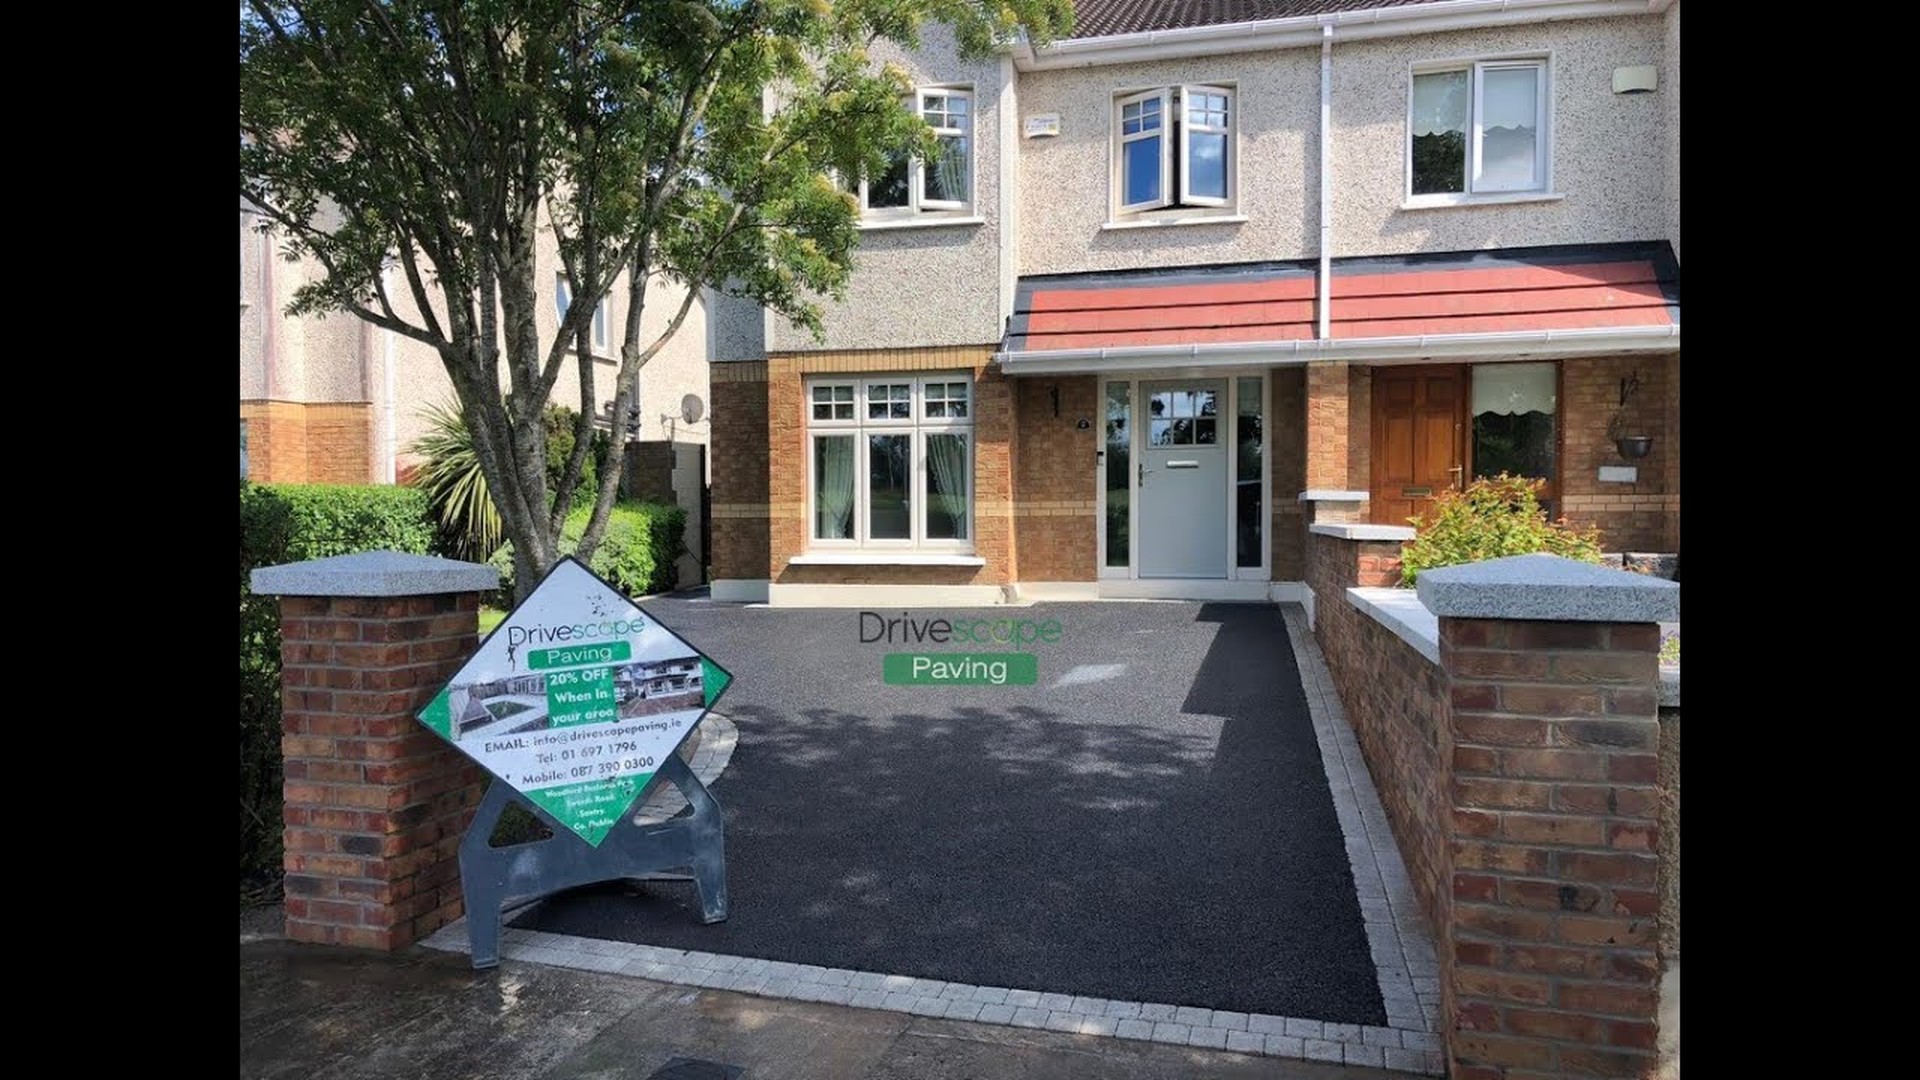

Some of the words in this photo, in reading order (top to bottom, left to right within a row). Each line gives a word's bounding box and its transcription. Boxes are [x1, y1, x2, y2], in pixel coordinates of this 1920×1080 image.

[508, 617, 645, 647] Drivescape
[547, 647, 612, 665] Paving
[549, 672, 578, 686] 20%
[581, 668, 609, 682] OFF
[554, 691, 592, 704] When
[552, 712, 581, 727] your
[585, 708, 614, 720] area
[485, 739, 529, 752] EMAIL:
[533, 718, 682, 746] info@drivescapepaving.ie
[535, 752, 557, 764] Tel:
[561, 749, 576, 760] 01
[581, 746, 602, 758] 697
[608, 741, 637, 754] 1796
[522, 770, 567, 784] Mobile:
[571, 765, 593, 778] 087
[598, 761, 620, 774] 390
[624, 756, 654, 770] 0300
